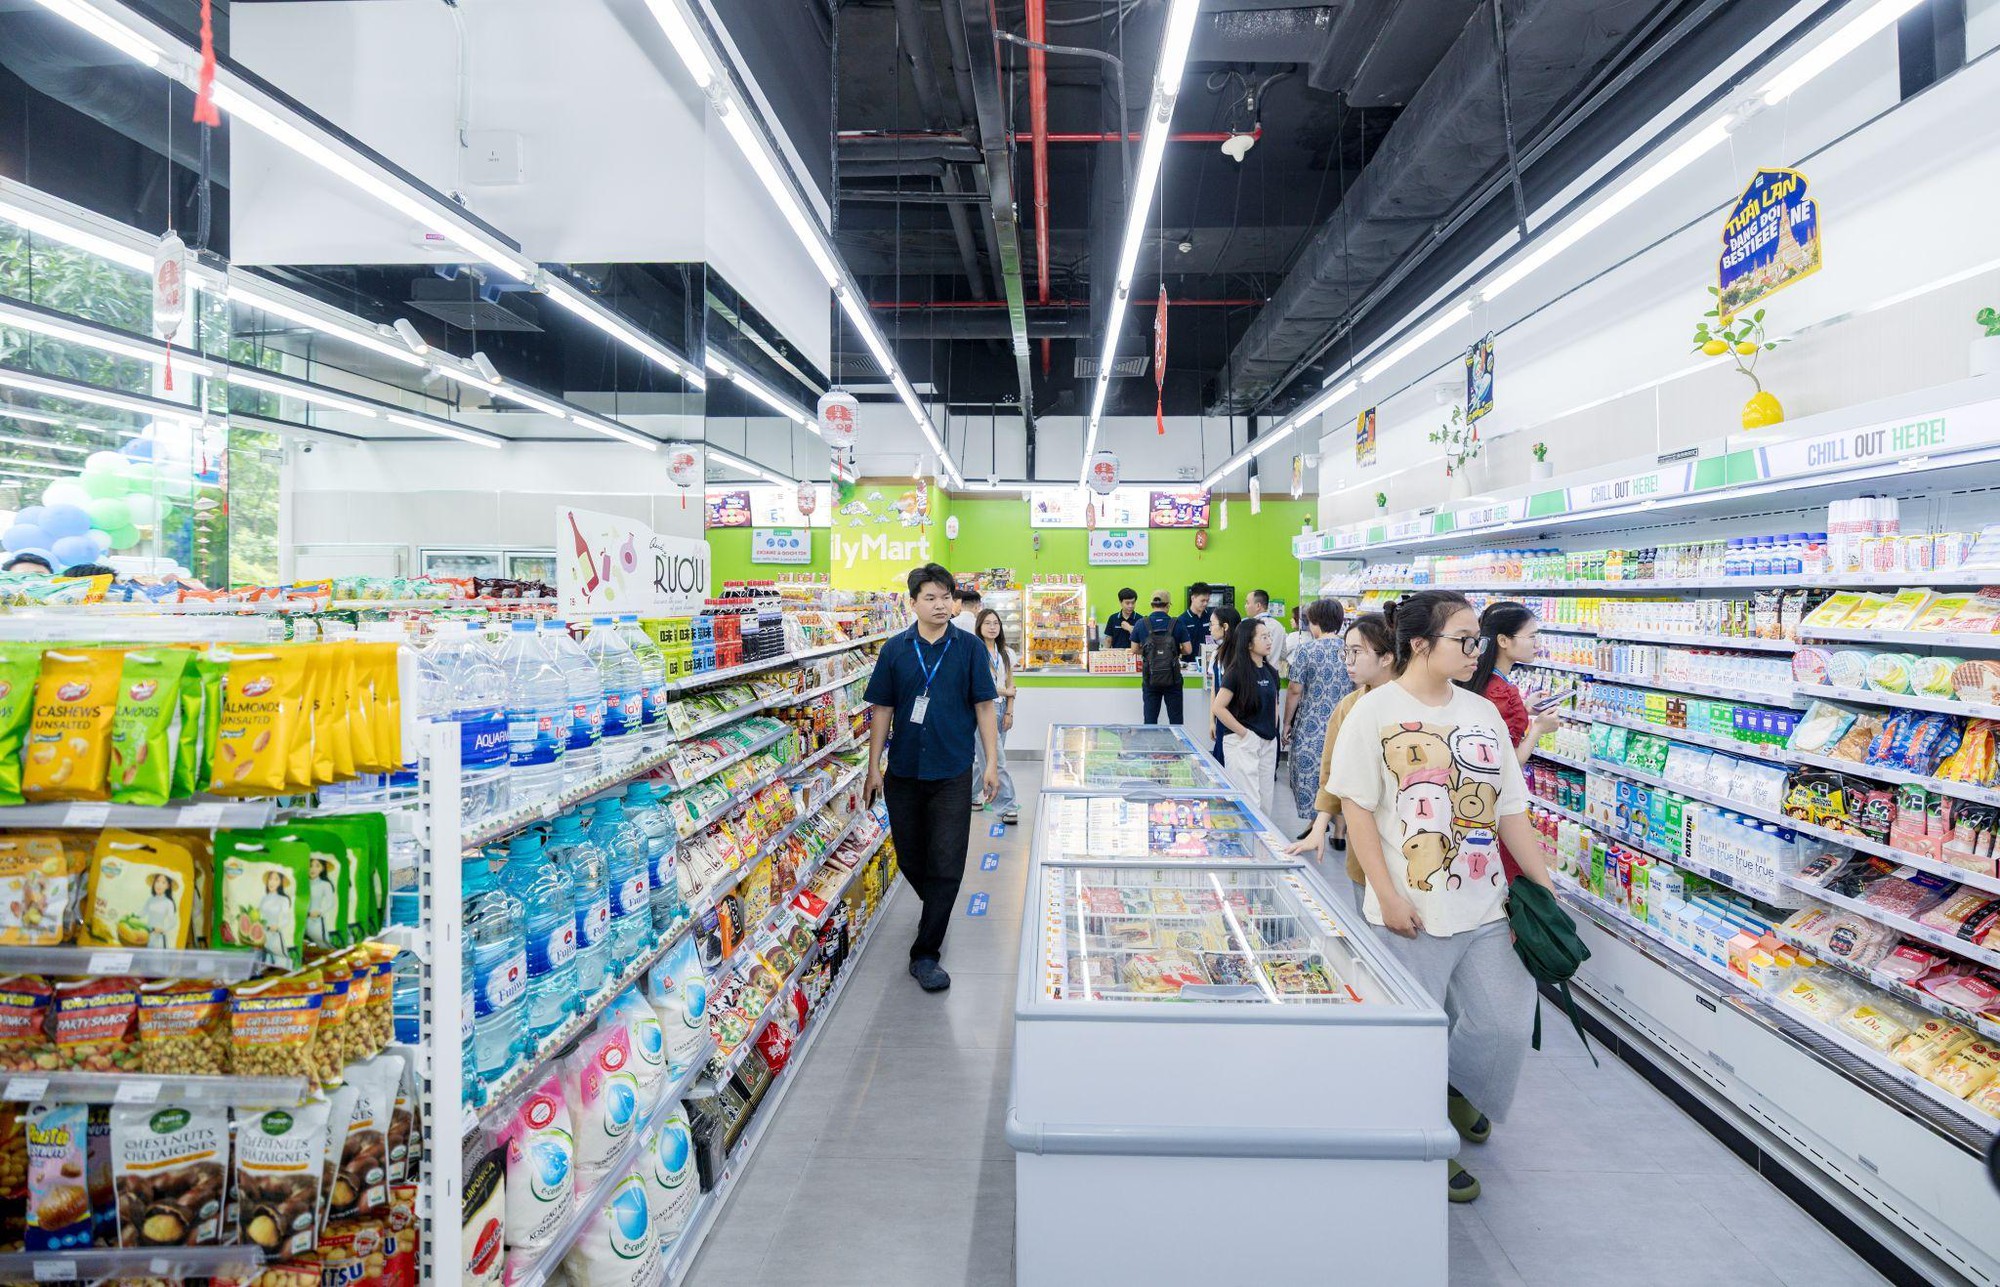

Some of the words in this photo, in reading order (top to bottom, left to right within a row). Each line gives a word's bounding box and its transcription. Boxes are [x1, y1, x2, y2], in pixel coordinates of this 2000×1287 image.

[1726, 199, 1760, 237] THÁI
[1762, 172, 1797, 208] LAN
[1808, 438, 1849, 467] CHILL
[1855, 430, 1886, 458] OUT
[1891, 418, 1946, 452] HERE!
[1591, 484, 1612, 503] CHILL
[1615, 480, 1630, 499] OUT
[1633, 474, 1658, 496] HERE!
[37, 706, 101, 718] CASHEWS
[223, 702, 281, 713] ALMONDS
[35, 720, 91, 730] UNSALTED
[1685, 814, 1693, 858] OATSIDE
[1717, 848, 1734, 862] true
[1735, 855, 1753, 869] true
[1755, 863, 1774, 878] true
[266, 997, 310, 1009] GARDEN
[57, 1017, 90, 1031] PARTY
[91, 1013, 130, 1026] SNACK
[124, 1127, 214, 1150] CHESTNUTS
[243, 1134, 309, 1150] CHESTNUTS
[466, 1161, 496, 1200] JAPONICA
